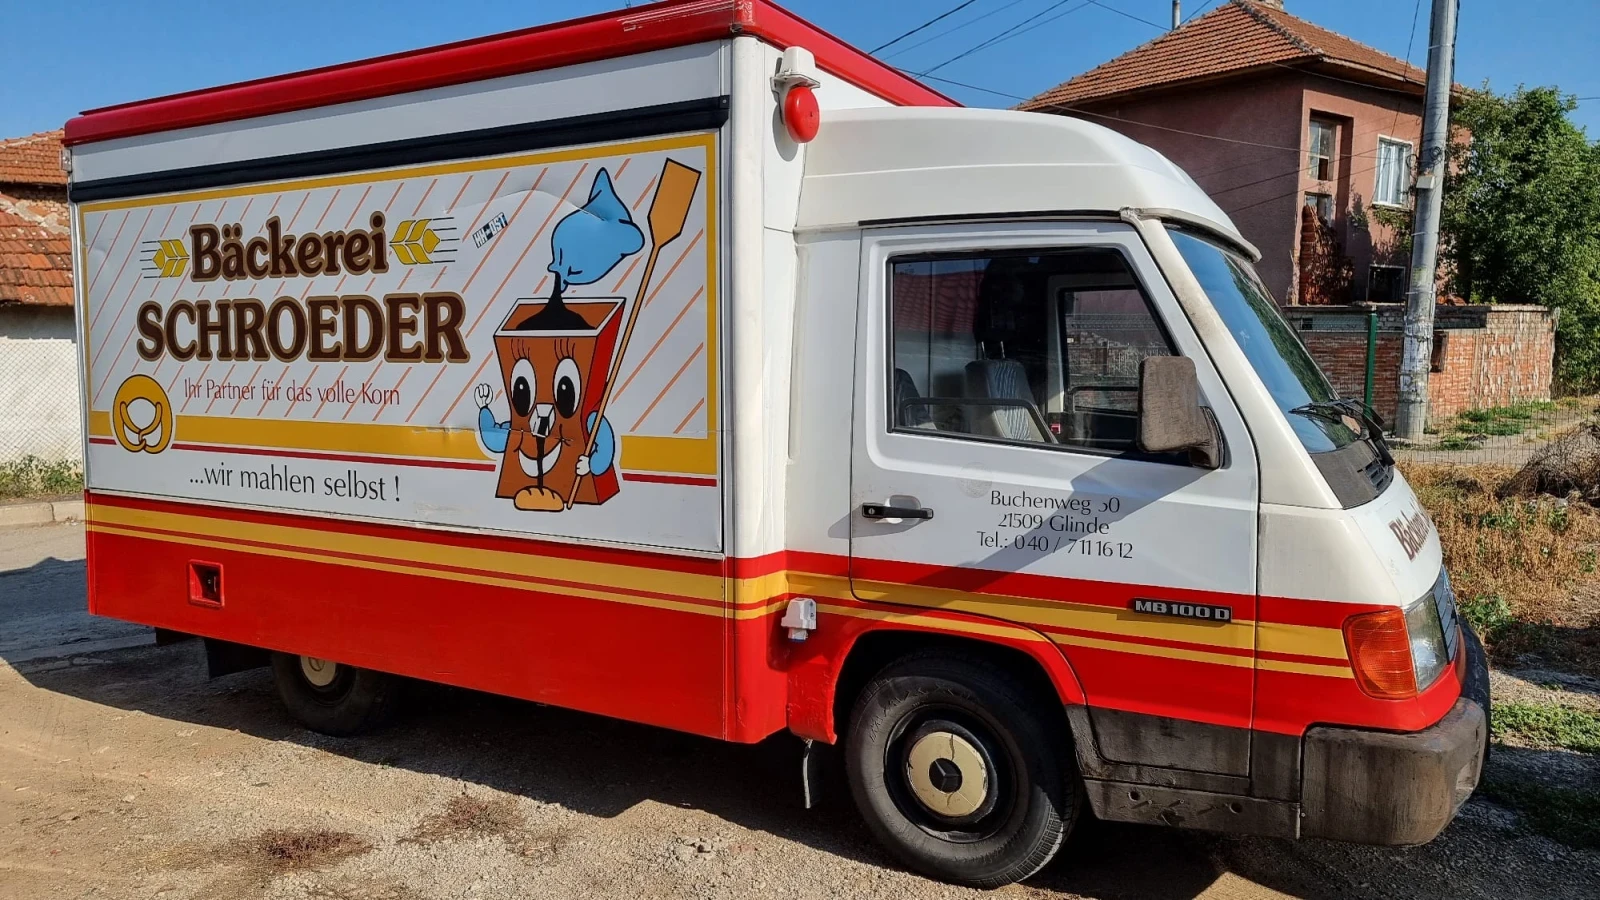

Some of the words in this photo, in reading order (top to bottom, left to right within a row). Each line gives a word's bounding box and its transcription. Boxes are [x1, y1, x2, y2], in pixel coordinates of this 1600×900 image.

[189, 211, 389, 282] Bäckerei
[137, 292, 471, 364] SCHROEDER
[184, 378, 202, 399] Ihr
[206, 379, 256, 402] Partner
[262, 379, 282, 402] für
[286, 380, 313, 403] das
[317, 380, 355, 404] volle
[360, 382, 400, 406] Korn
[189, 462, 233, 487] ...wir
[240, 464, 315, 494] mahlen
[324, 469, 386, 502] selbst
[990, 490, 1092, 516] Buchenweg
[998, 512, 1043, 530] 21509
[1049, 514, 1110, 535] Glinde
[976, 531, 1008, 548] Tel.:
[1135, 600, 1167, 614] MB
[1171, 603, 1210, 618] 100
[1214, 608, 1230, 620] D
